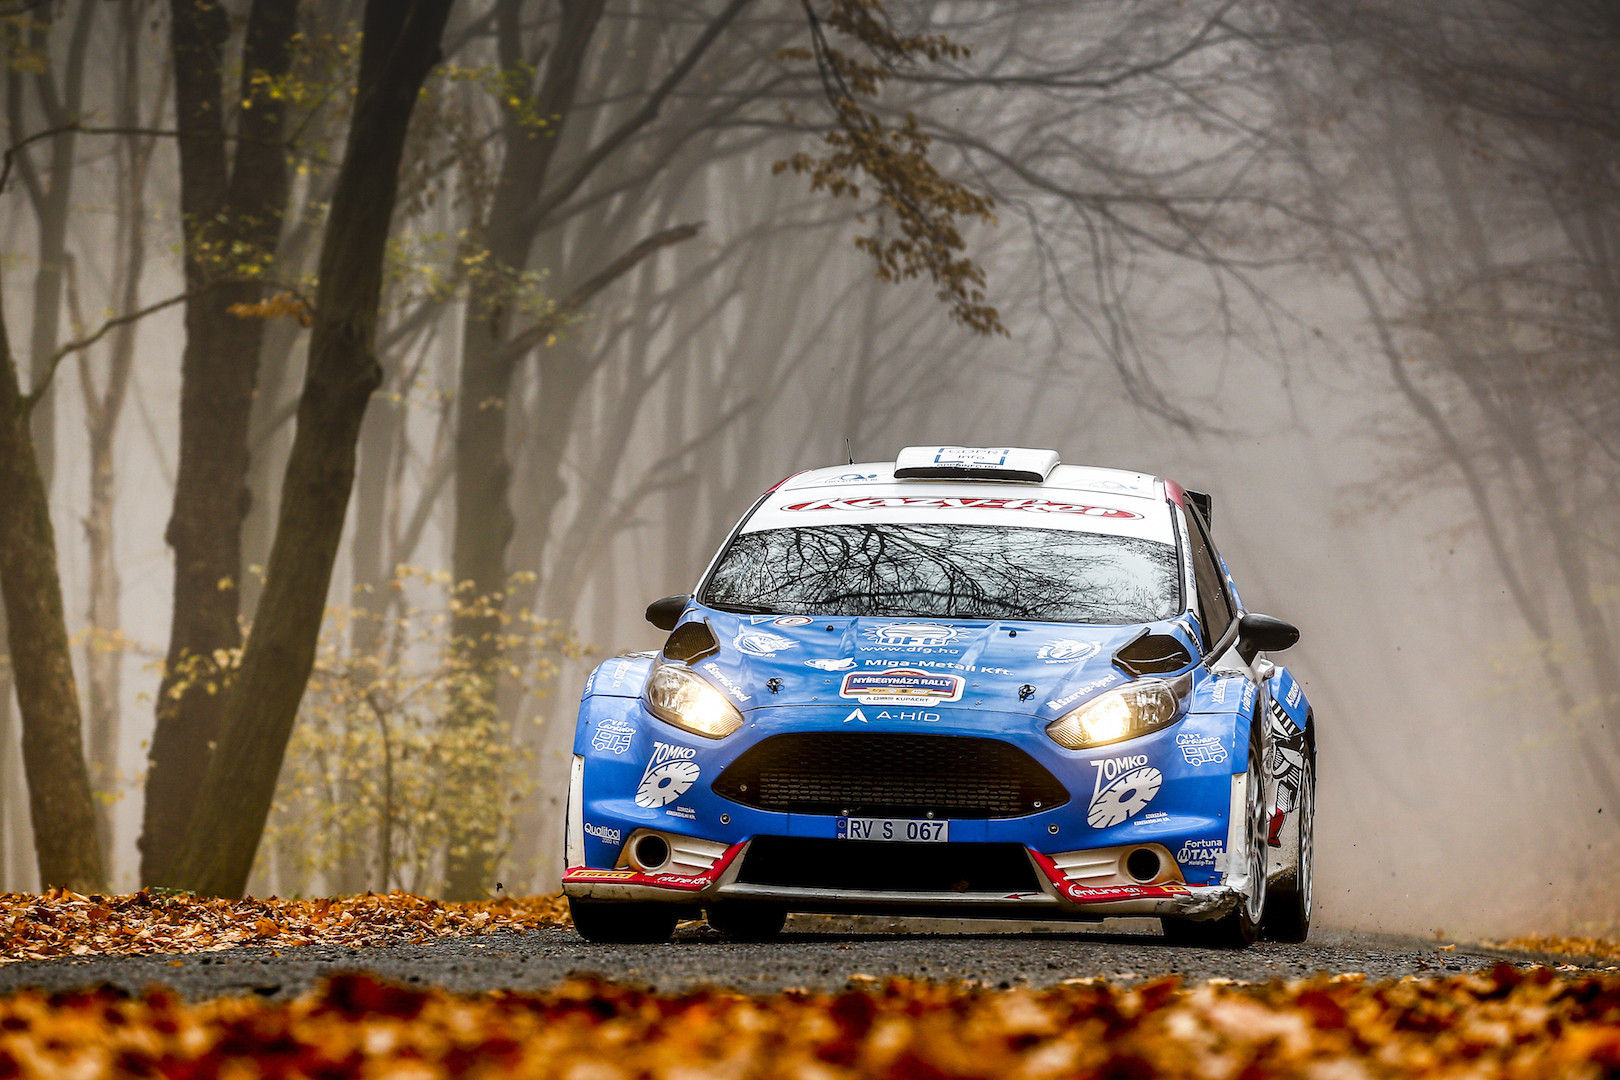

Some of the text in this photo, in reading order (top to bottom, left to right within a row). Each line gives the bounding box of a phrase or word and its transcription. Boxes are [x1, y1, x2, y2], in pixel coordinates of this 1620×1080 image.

[859, 647, 959, 655] www.dfg.hu
[864, 659, 977, 673] Miga-Metall
[852, 676, 952, 688] NYÍREGYHÁZA RALLY
[876, 710, 941, 723] A-HÍD
[584, 822, 621, 840] Qualitool
[850, 820, 944, 841] RV S 067
[1184, 839, 1223, 848] Fortuna
